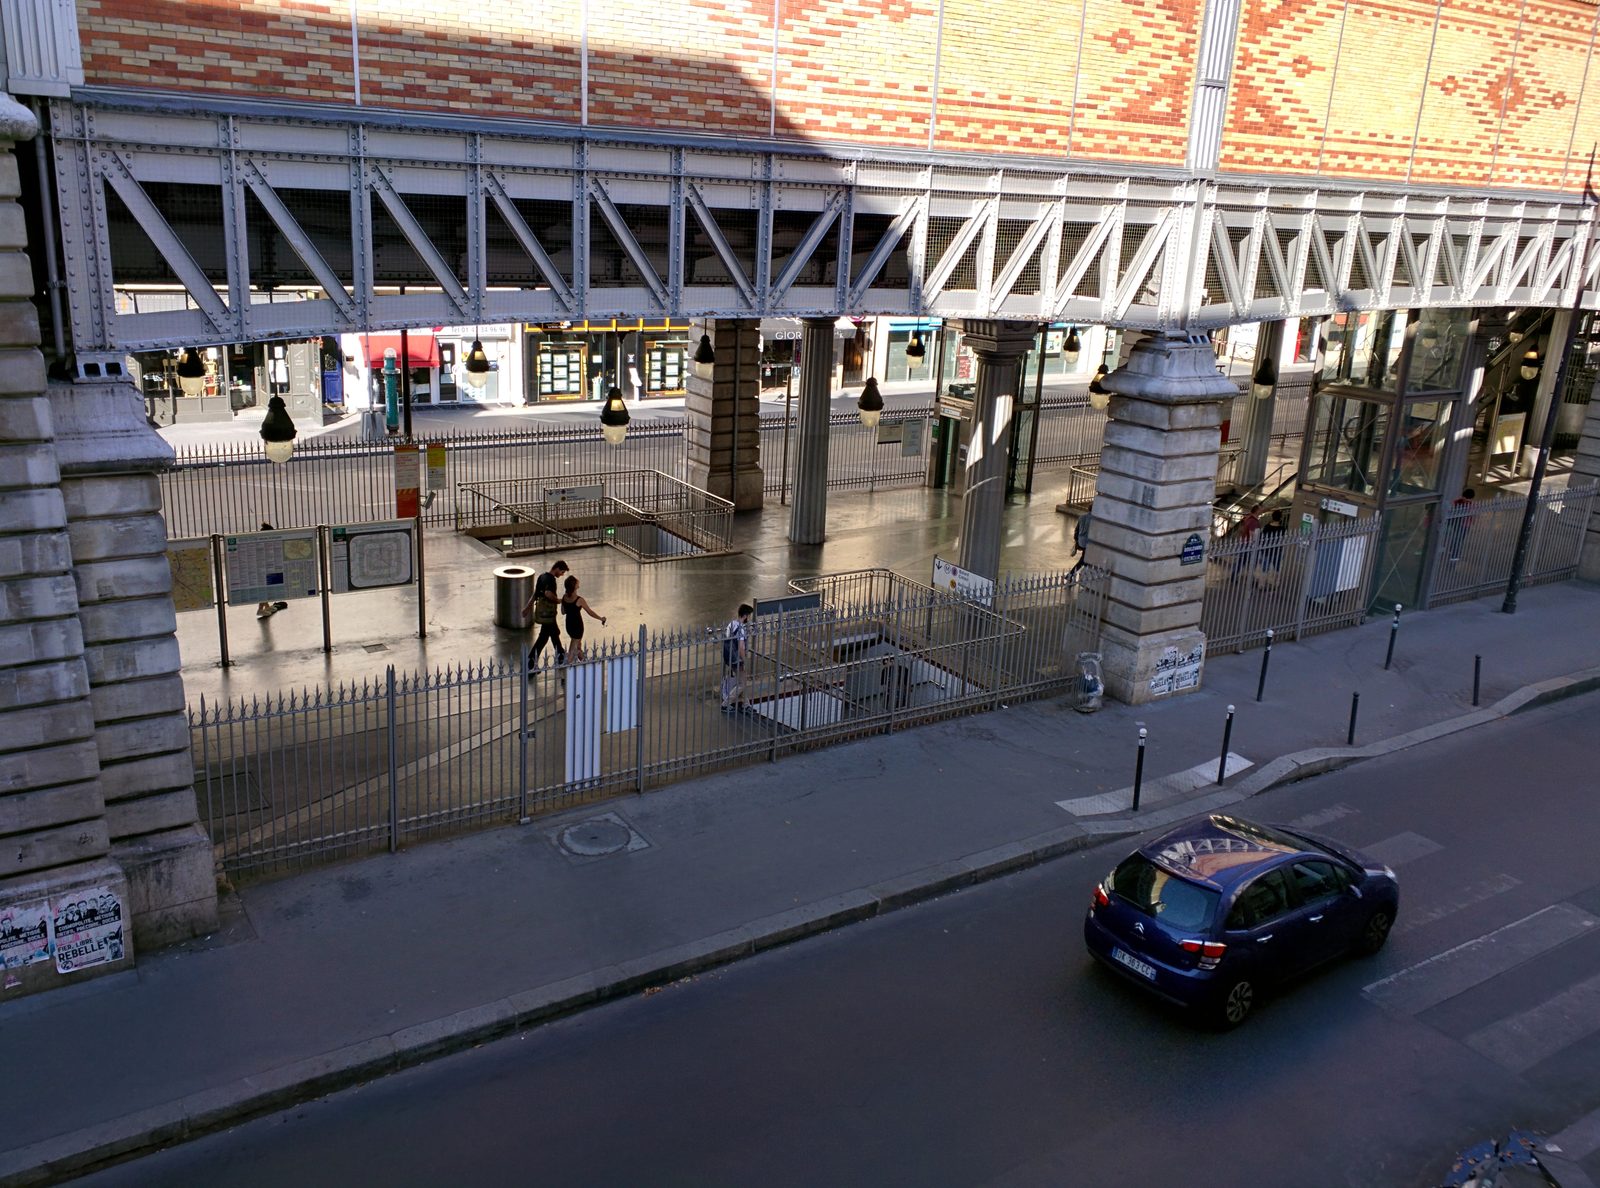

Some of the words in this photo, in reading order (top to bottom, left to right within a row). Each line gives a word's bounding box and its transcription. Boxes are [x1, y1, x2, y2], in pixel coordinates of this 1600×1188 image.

[58, 945, 74, 953] FIER,
[76, 938, 94, 947] LIBRE
[58, 940, 105, 963] REBELLE
